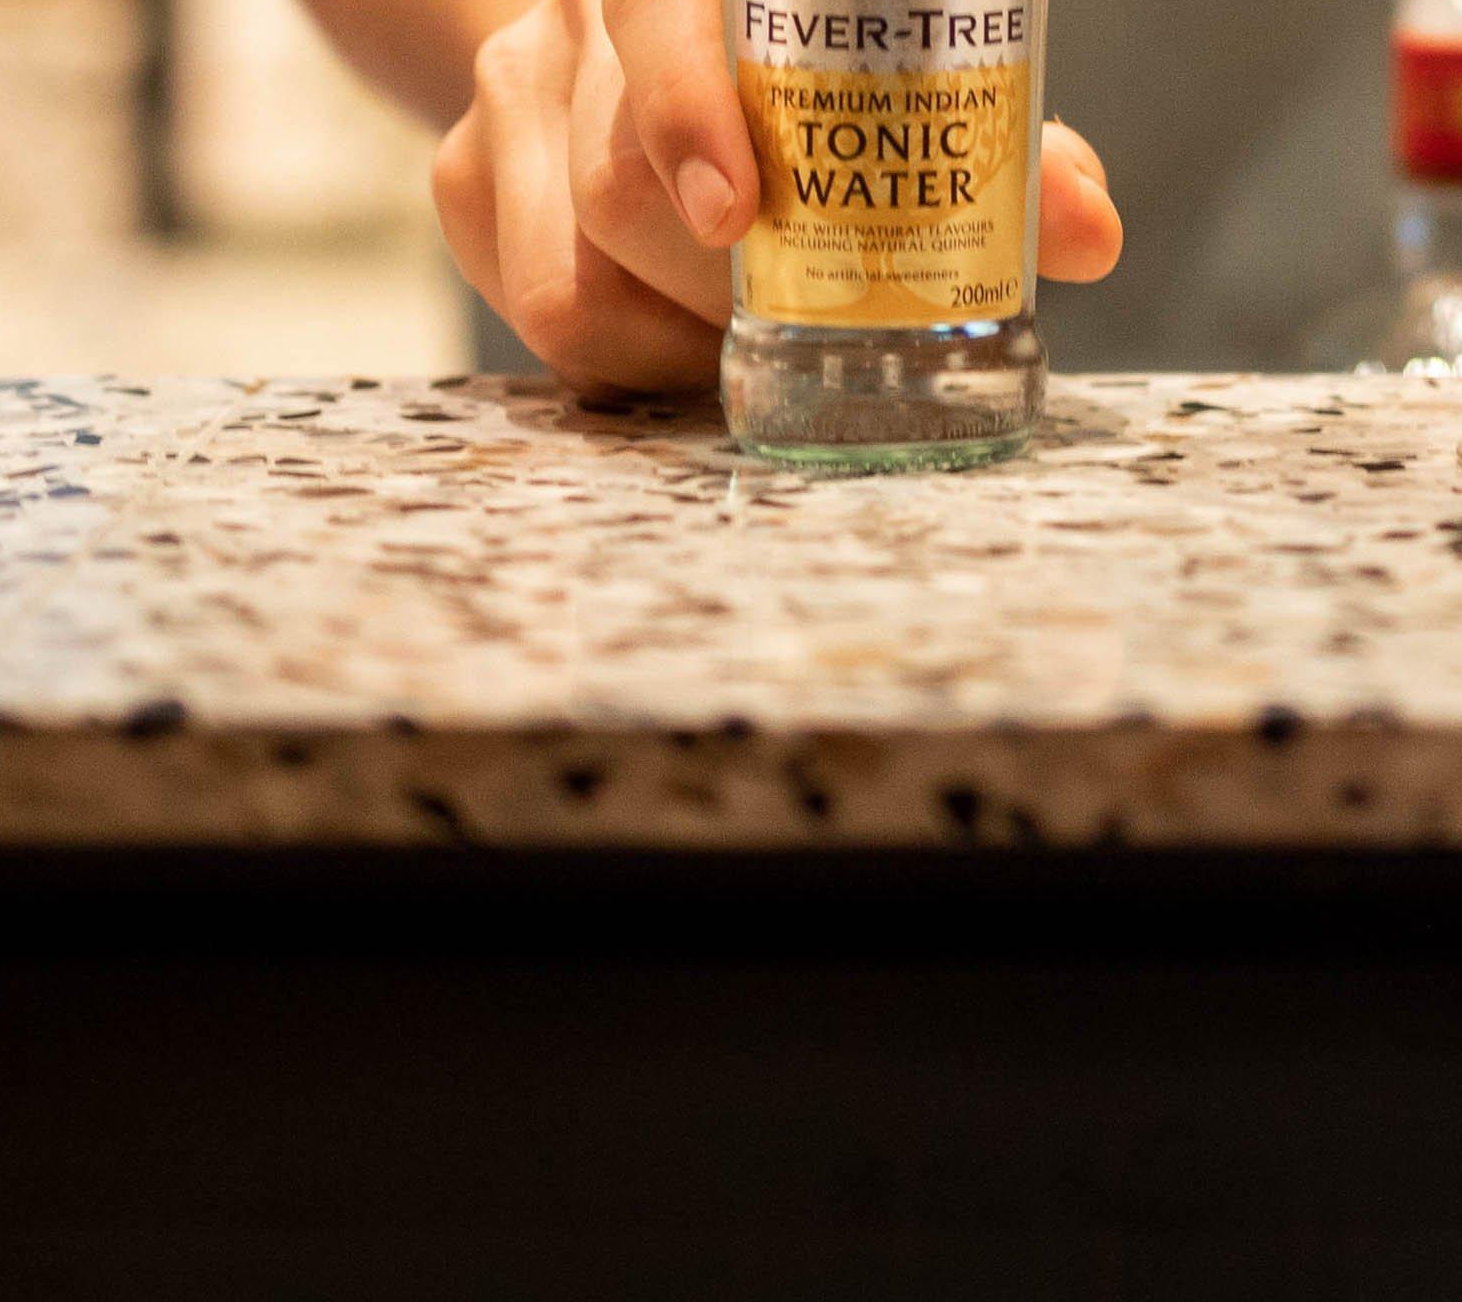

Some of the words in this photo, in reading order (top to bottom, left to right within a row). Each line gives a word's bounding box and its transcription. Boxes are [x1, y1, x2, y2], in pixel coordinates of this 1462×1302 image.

[745, 0, 1024, 51] FEVER-TREE
[770, 86, 891, 113] PREMIUM
[905, 86, 997, 112] INDIAN
[797, 120, 969, 162] TONIC
[792, 167, 975, 208] WATER
[771, 218, 806, 234] MADE
[813, 222, 850, 238] WITH
[854, 224, 922, 238] NATURAL
[929, 220, 994, 236] FLAVOURS
[779, 235, 853, 253] INCLUDING
[857, 239, 925, 253] NATURAL
[930, 235, 986, 253] QUININE
[805, 265, 824, 280] No
[827, 268, 881, 282] artificial
[886, 269, 959, 282] sweeteners
[951, 280, 1004, 309] 200ml
